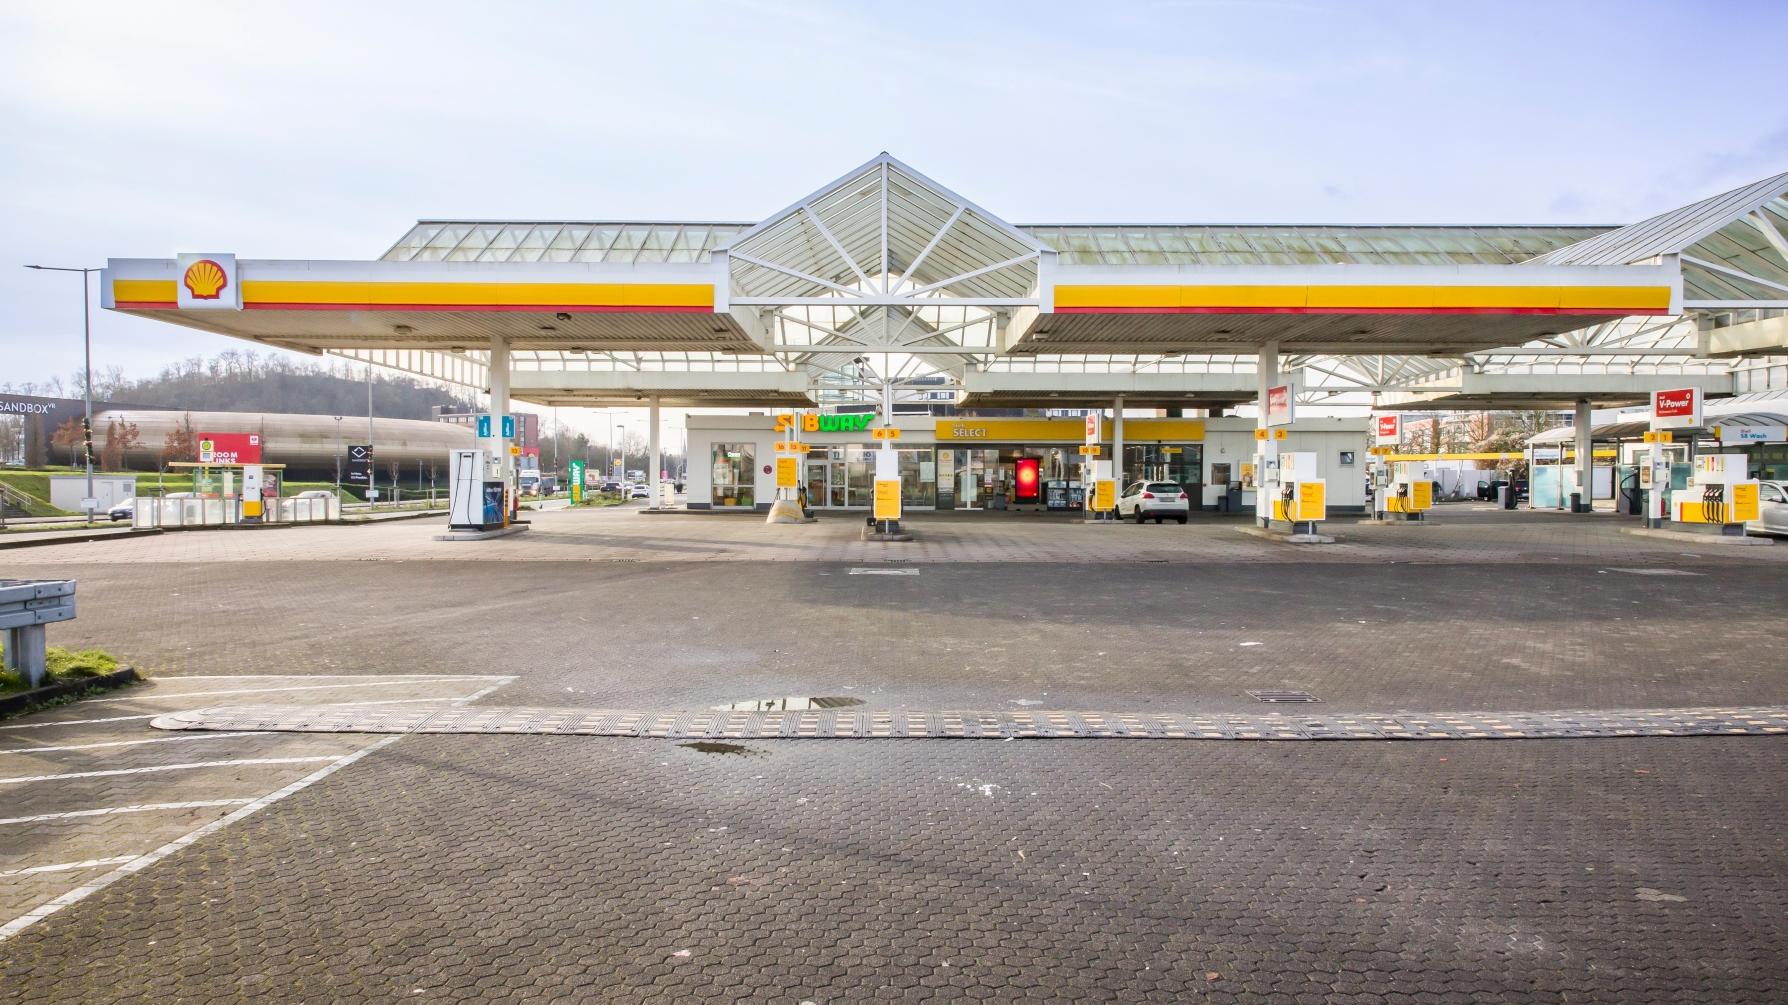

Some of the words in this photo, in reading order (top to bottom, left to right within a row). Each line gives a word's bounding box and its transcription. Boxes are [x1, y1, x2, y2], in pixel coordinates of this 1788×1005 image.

[0, 401, 49, 414] SANDBOX
[1659, 399, 1689, 409] V-Power
[877, 430, 883, 438] 6
[890, 430, 896, 438] 5
[953, 428, 986, 437] SELECT
[572, 462, 581, 502] SUBWAY
